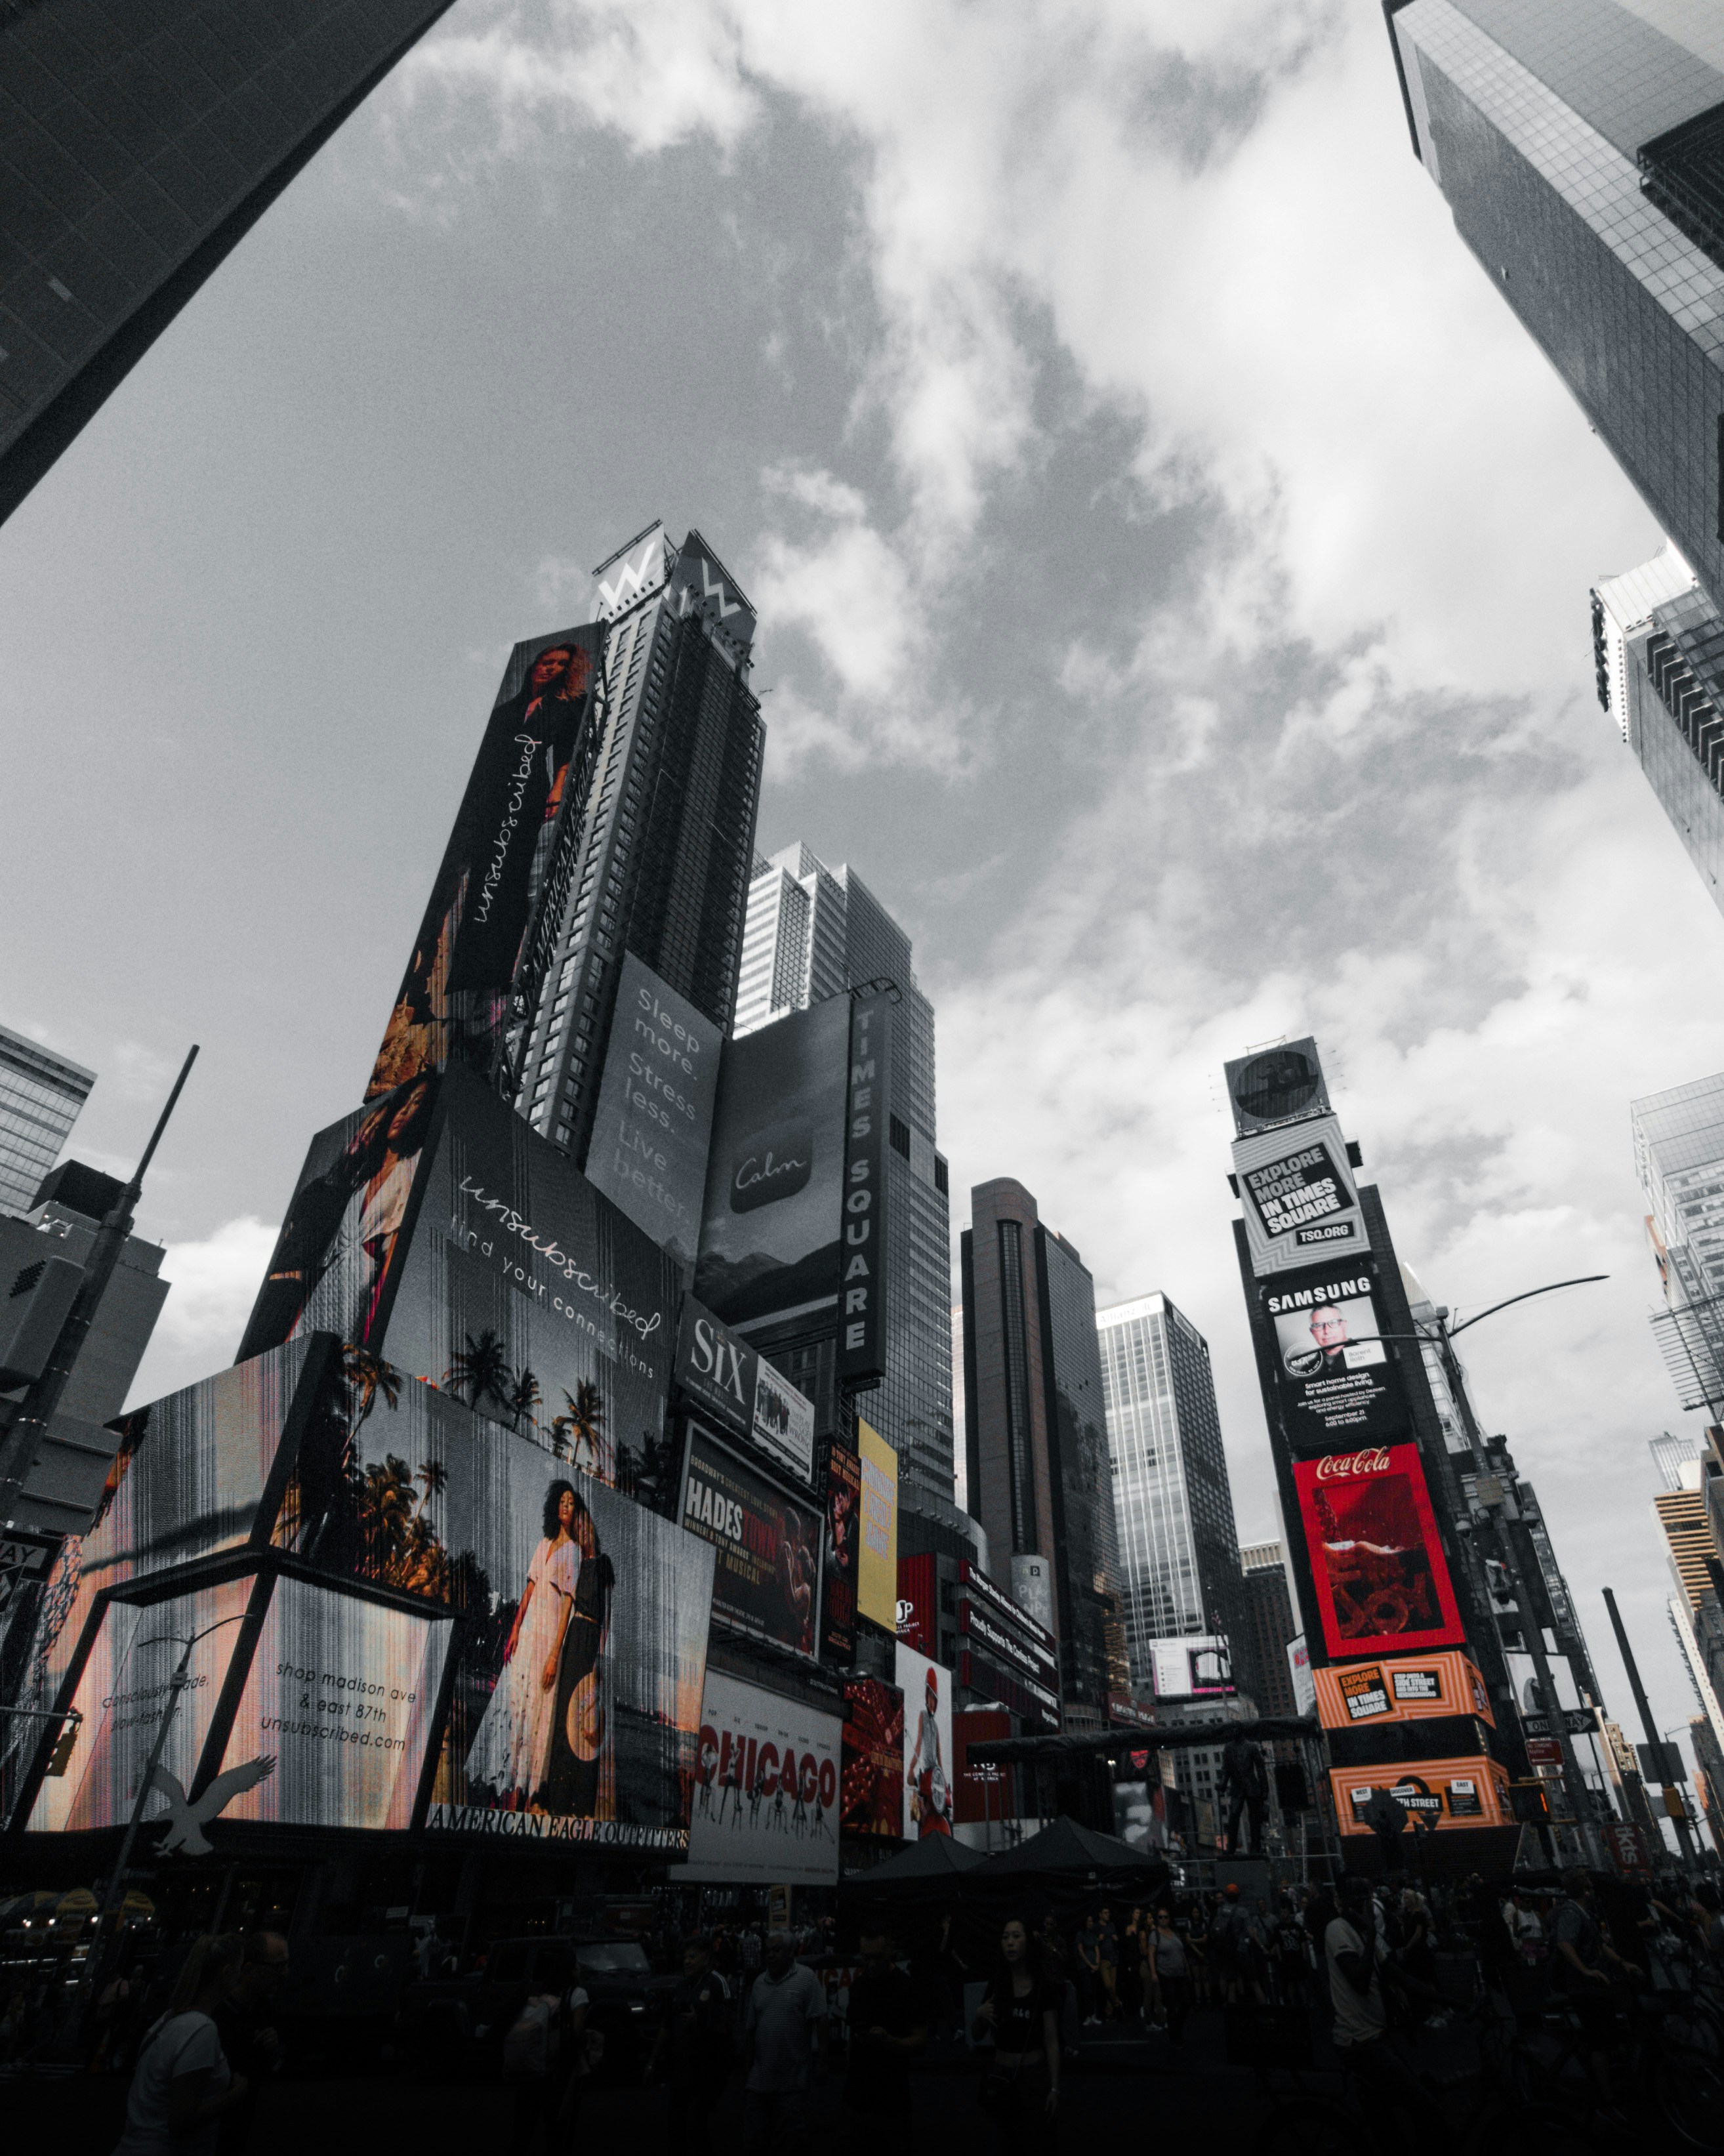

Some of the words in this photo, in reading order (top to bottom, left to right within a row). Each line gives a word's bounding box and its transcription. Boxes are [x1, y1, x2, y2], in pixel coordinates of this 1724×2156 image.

[598, 541, 655, 610] W
[474, 734, 543, 923] unsubscribed
[638, 989, 699, 1053] Sleep
[635, 1018, 697, 1081] more.
[628, 1052, 695, 1120] Stress
[852, 1010, 875, 1138] TIMES
[626, 1077, 675, 1134] less.
[619, 1120, 667, 1171] Live
[735, 1151, 808, 1189] Calm
[1248, 1147, 1324, 1190] EXPLORE
[1254, 1172, 1307, 1204] MORE
[1260, 1199, 1283, 1219] IN
[1281, 1177, 1337, 1211] TIMES
[1267, 1194, 1340, 1234] SQUARE
[1300, 1224, 1349, 1243] TSQ.ORG
[460, 1176, 661, 1340] unsubscribed
[844, 1159, 872, 1350] SQUARE
[1268, 1277, 1371, 1313] SAMSUNG
[503, 1256, 546, 1296] your
[553, 1296, 653, 1379] connections
[691, 1319, 747, 1405] SIX
[1348, 1348, 1371, 1358] Barent
[1349, 1355, 1365, 1363] Roth
[1305, 1380, 1326, 1389] Smart
[1346, 1372, 1370, 1381] design
[1316, 1382, 1354, 1394] sustainable
[1324, 1411, 1358, 1421] September
[690, 1455, 724, 1484] BROADWAY'S
[1317, 1445, 1390, 1480] Coca-Cola
[0, 1543, 37, 1563] AY
[715, 1533, 729, 1548] TONY
[729, 1541, 749, 1560] AWARDS
[726, 1553, 760, 1585] MUSICAL
[276, 1661, 316, 1684] shop
[321, 1670, 385, 1696] madison
[390, 1690, 417, 1704] ave
[1341, 1668, 1380, 1687] EXPLORE
[1344, 1682, 1370, 1697] MORE
[300, 1694, 311, 1707] &
[318, 1699, 351, 1717] east
[356, 1705, 387, 1723] 87th
[1347, 1696, 1359, 1707] IN
[1358, 1690, 1385, 1705] TIMES
[1350, 1703, 1387, 1719] SQUARE
[261, 1716, 406, 1751] unsubscribed.com
[695, 1724, 836, 1808] CHICAGO
[1391, 1787, 1413, 1795] DISCOVER
[1410, 1798, 1439, 1808] STREET
[431, 1804, 544, 1837] AMERICAN
[548, 1816, 600, 1843] EAGLE
[604, 1821, 689, 1848] OUTFITTERS
[1614, 1825, 1638, 1865] tkts
